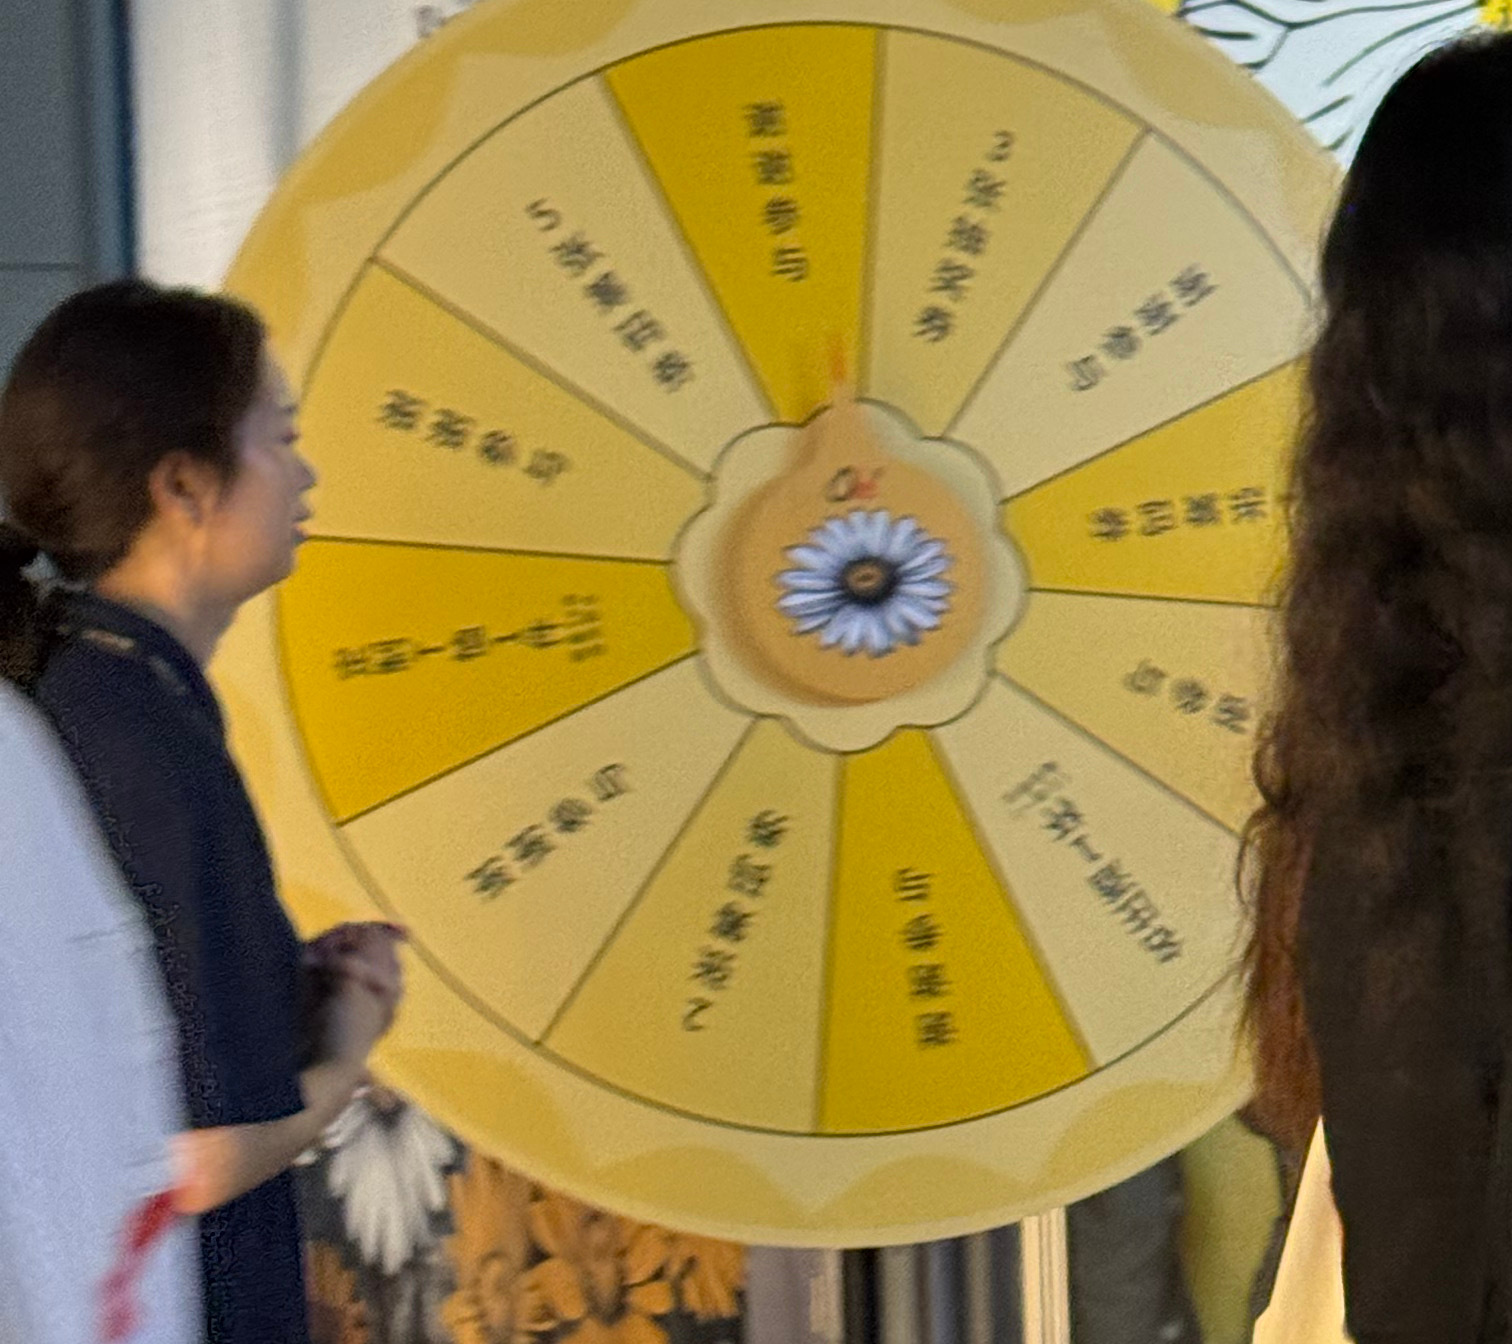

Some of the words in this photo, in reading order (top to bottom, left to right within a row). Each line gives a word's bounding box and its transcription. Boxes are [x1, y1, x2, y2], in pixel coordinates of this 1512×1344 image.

[743, 101, 810, 284] 谢谢参与
[1068, 265, 1218, 394] 谢谢参与
[376, 389, 569, 484] 谢谢参与
[1089, 486, 1268, 544] 张筹码券
[1122, 660, 1252, 735] 谢参与
[463, 762, 629, 901] 谢谢参与
[893, 866, 958, 1049] 谢谢参与
